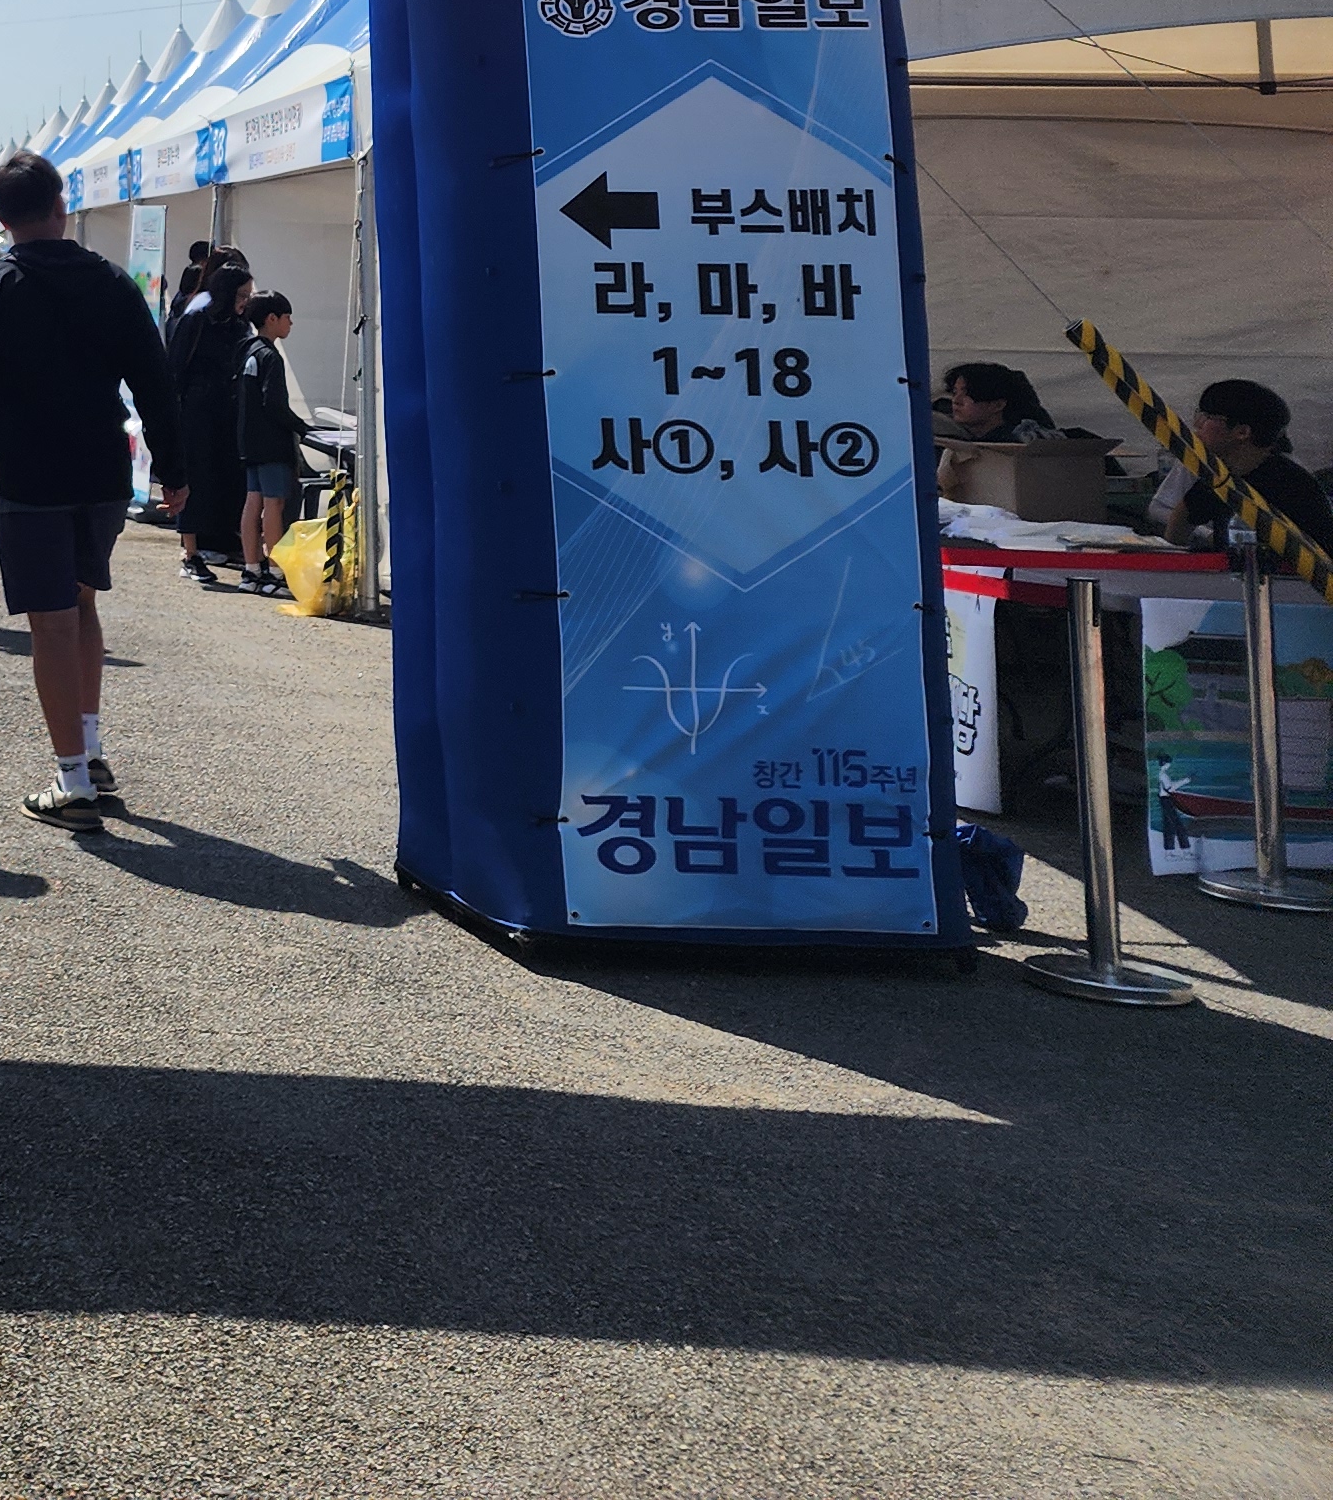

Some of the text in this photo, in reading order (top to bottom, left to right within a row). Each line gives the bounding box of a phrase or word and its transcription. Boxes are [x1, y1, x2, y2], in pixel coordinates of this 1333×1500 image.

[690, 187, 877, 236] 부스배치
[594, 262, 862, 324] 라, 마, 바
[652, 346, 813, 398] 1~18
[753, 747, 918, 793] 창간 115주년
[576, 793, 921, 878] 경남일보
